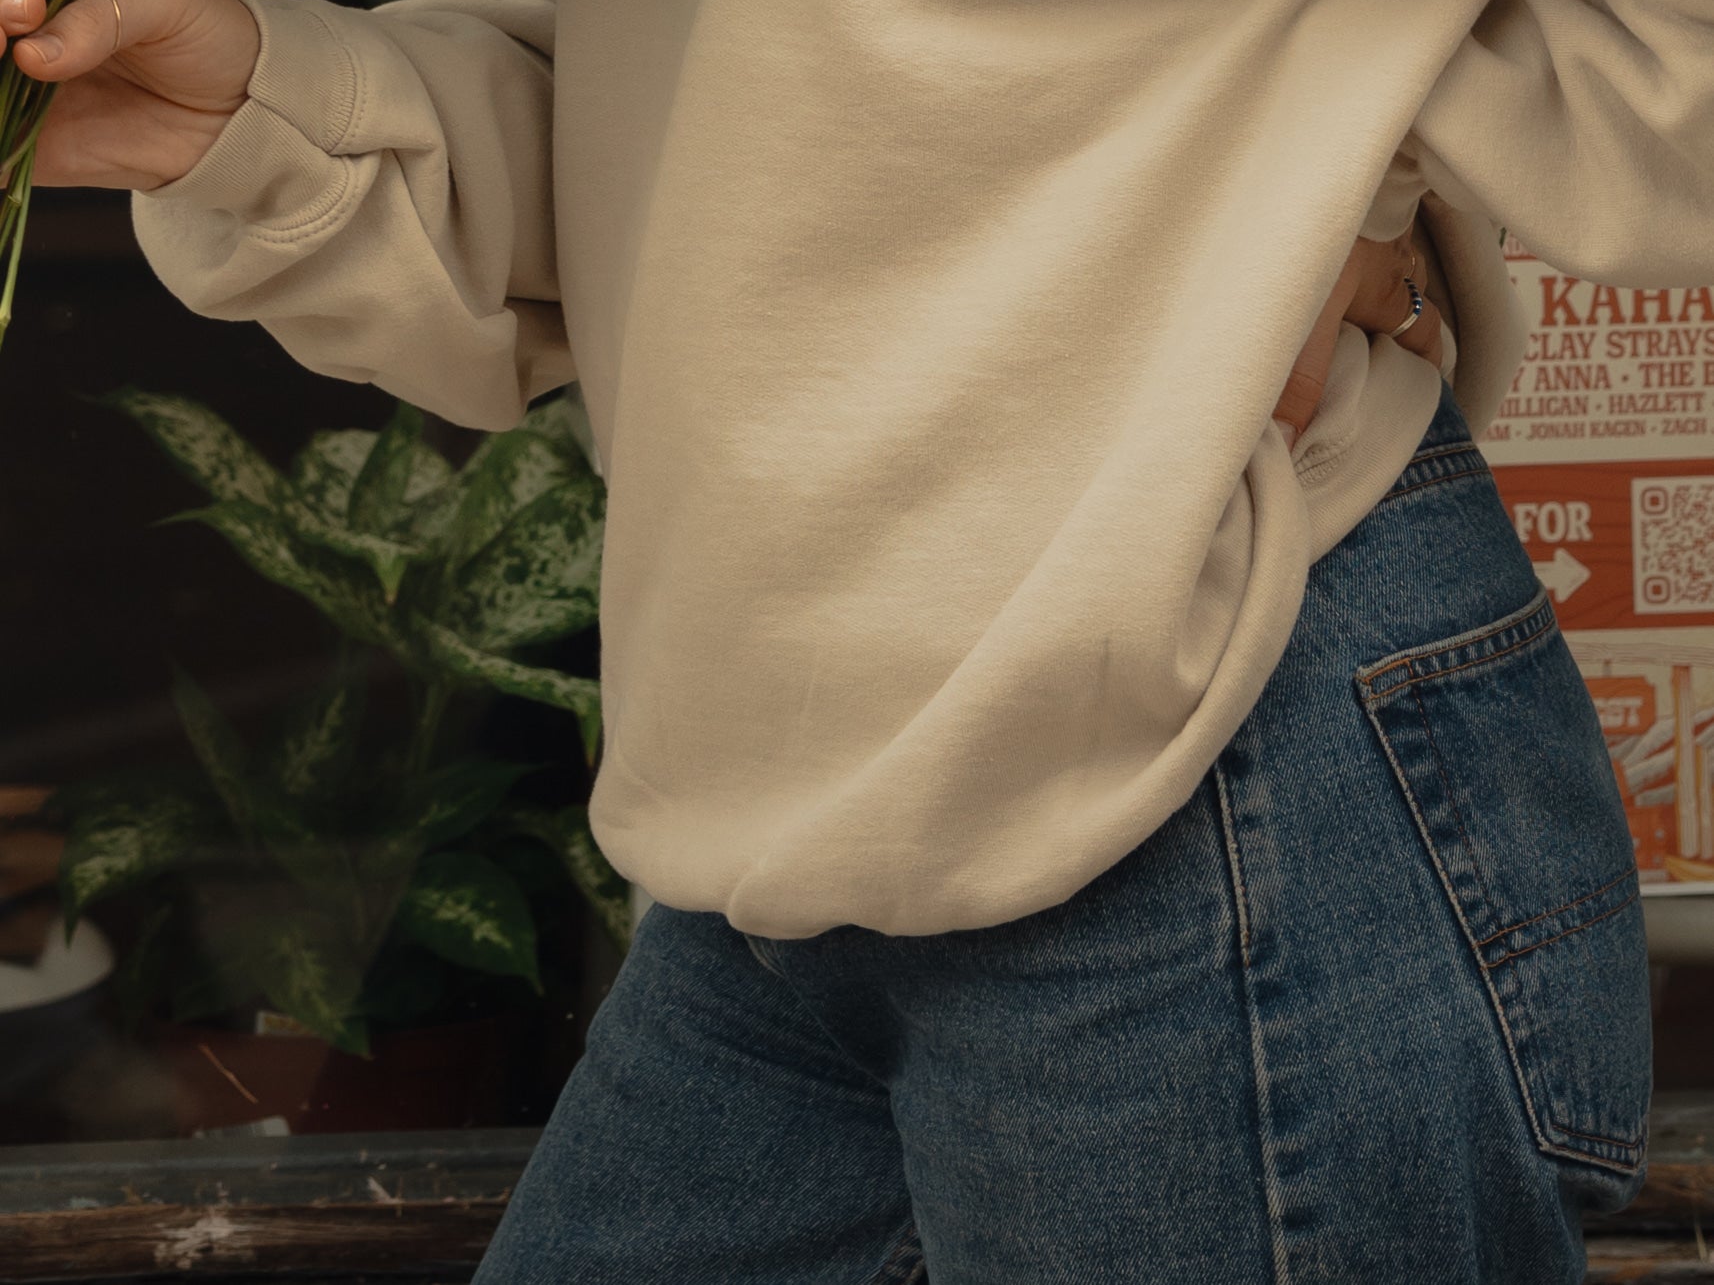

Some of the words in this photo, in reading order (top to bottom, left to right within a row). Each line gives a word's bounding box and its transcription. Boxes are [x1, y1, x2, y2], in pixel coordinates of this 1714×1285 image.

[1534, 365, 1611, 393] ANNA
[1638, 362, 1695, 389] THE
[1608, 392, 1705, 414] HAZLETT
[1512, 500, 1594, 544] FOR
